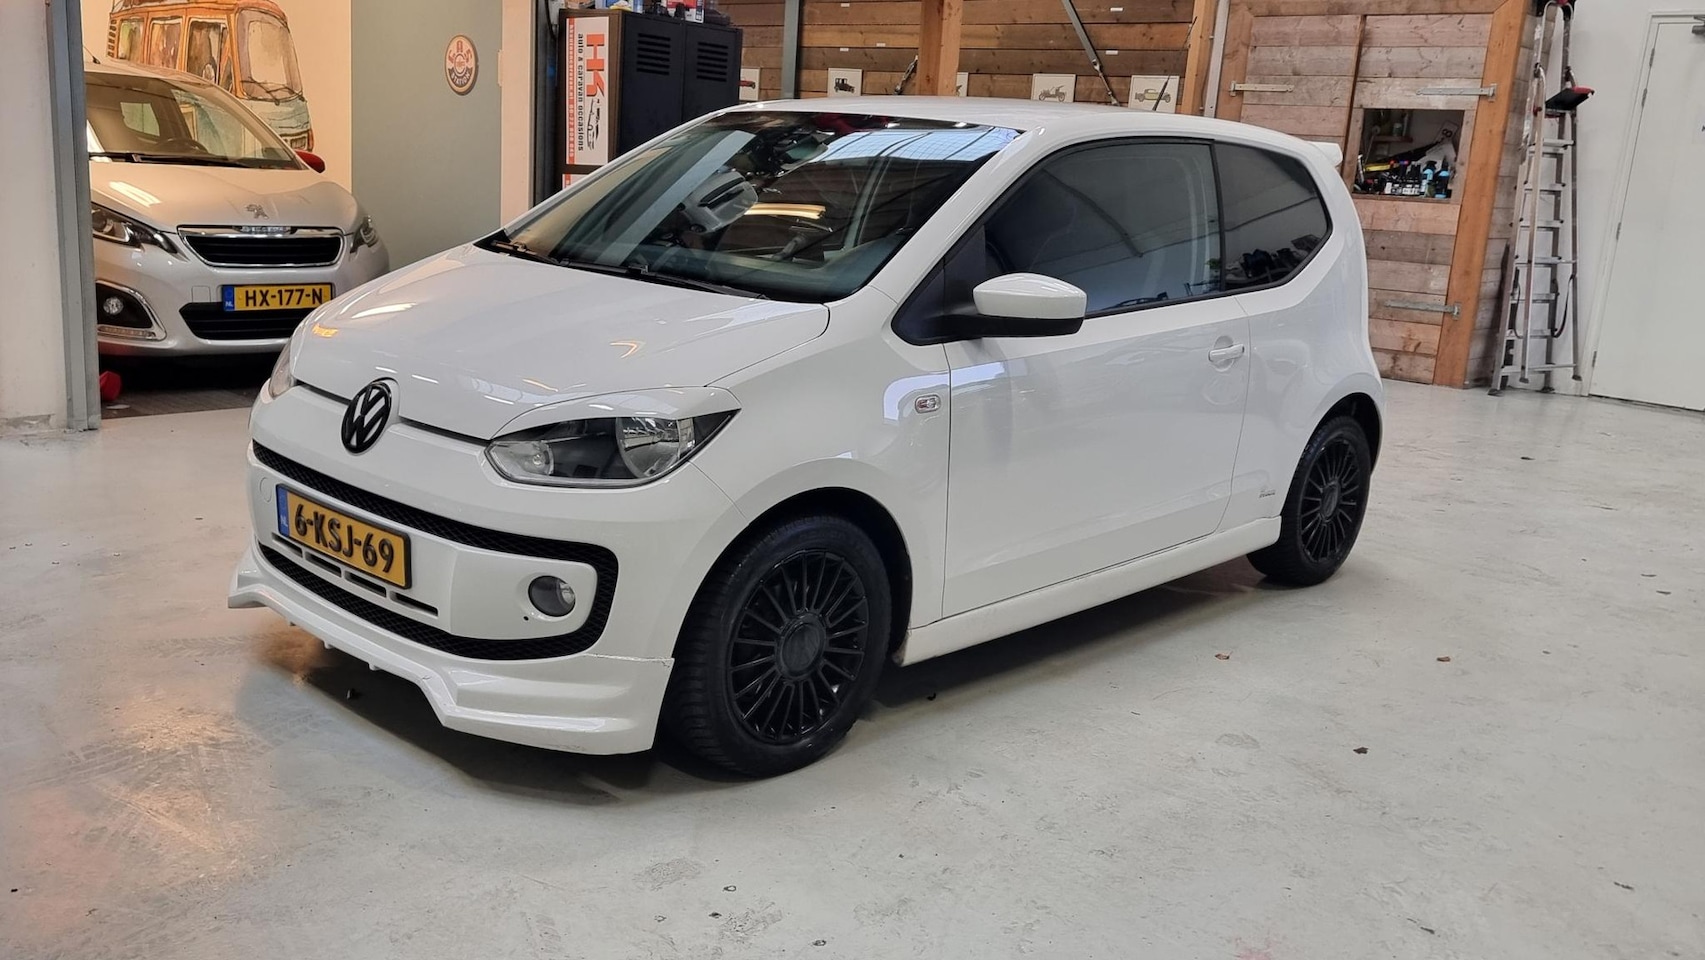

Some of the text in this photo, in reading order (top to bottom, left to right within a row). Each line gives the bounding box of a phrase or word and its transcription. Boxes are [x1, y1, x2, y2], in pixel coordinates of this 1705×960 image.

[448, 40, 472, 63] GAS
[586, 33, 604, 97] HK
[451, 72, 471, 85] STATION
[245, 288, 323, 307] HX-177-N
[294, 503, 394, 573] 6-KSJ-69
